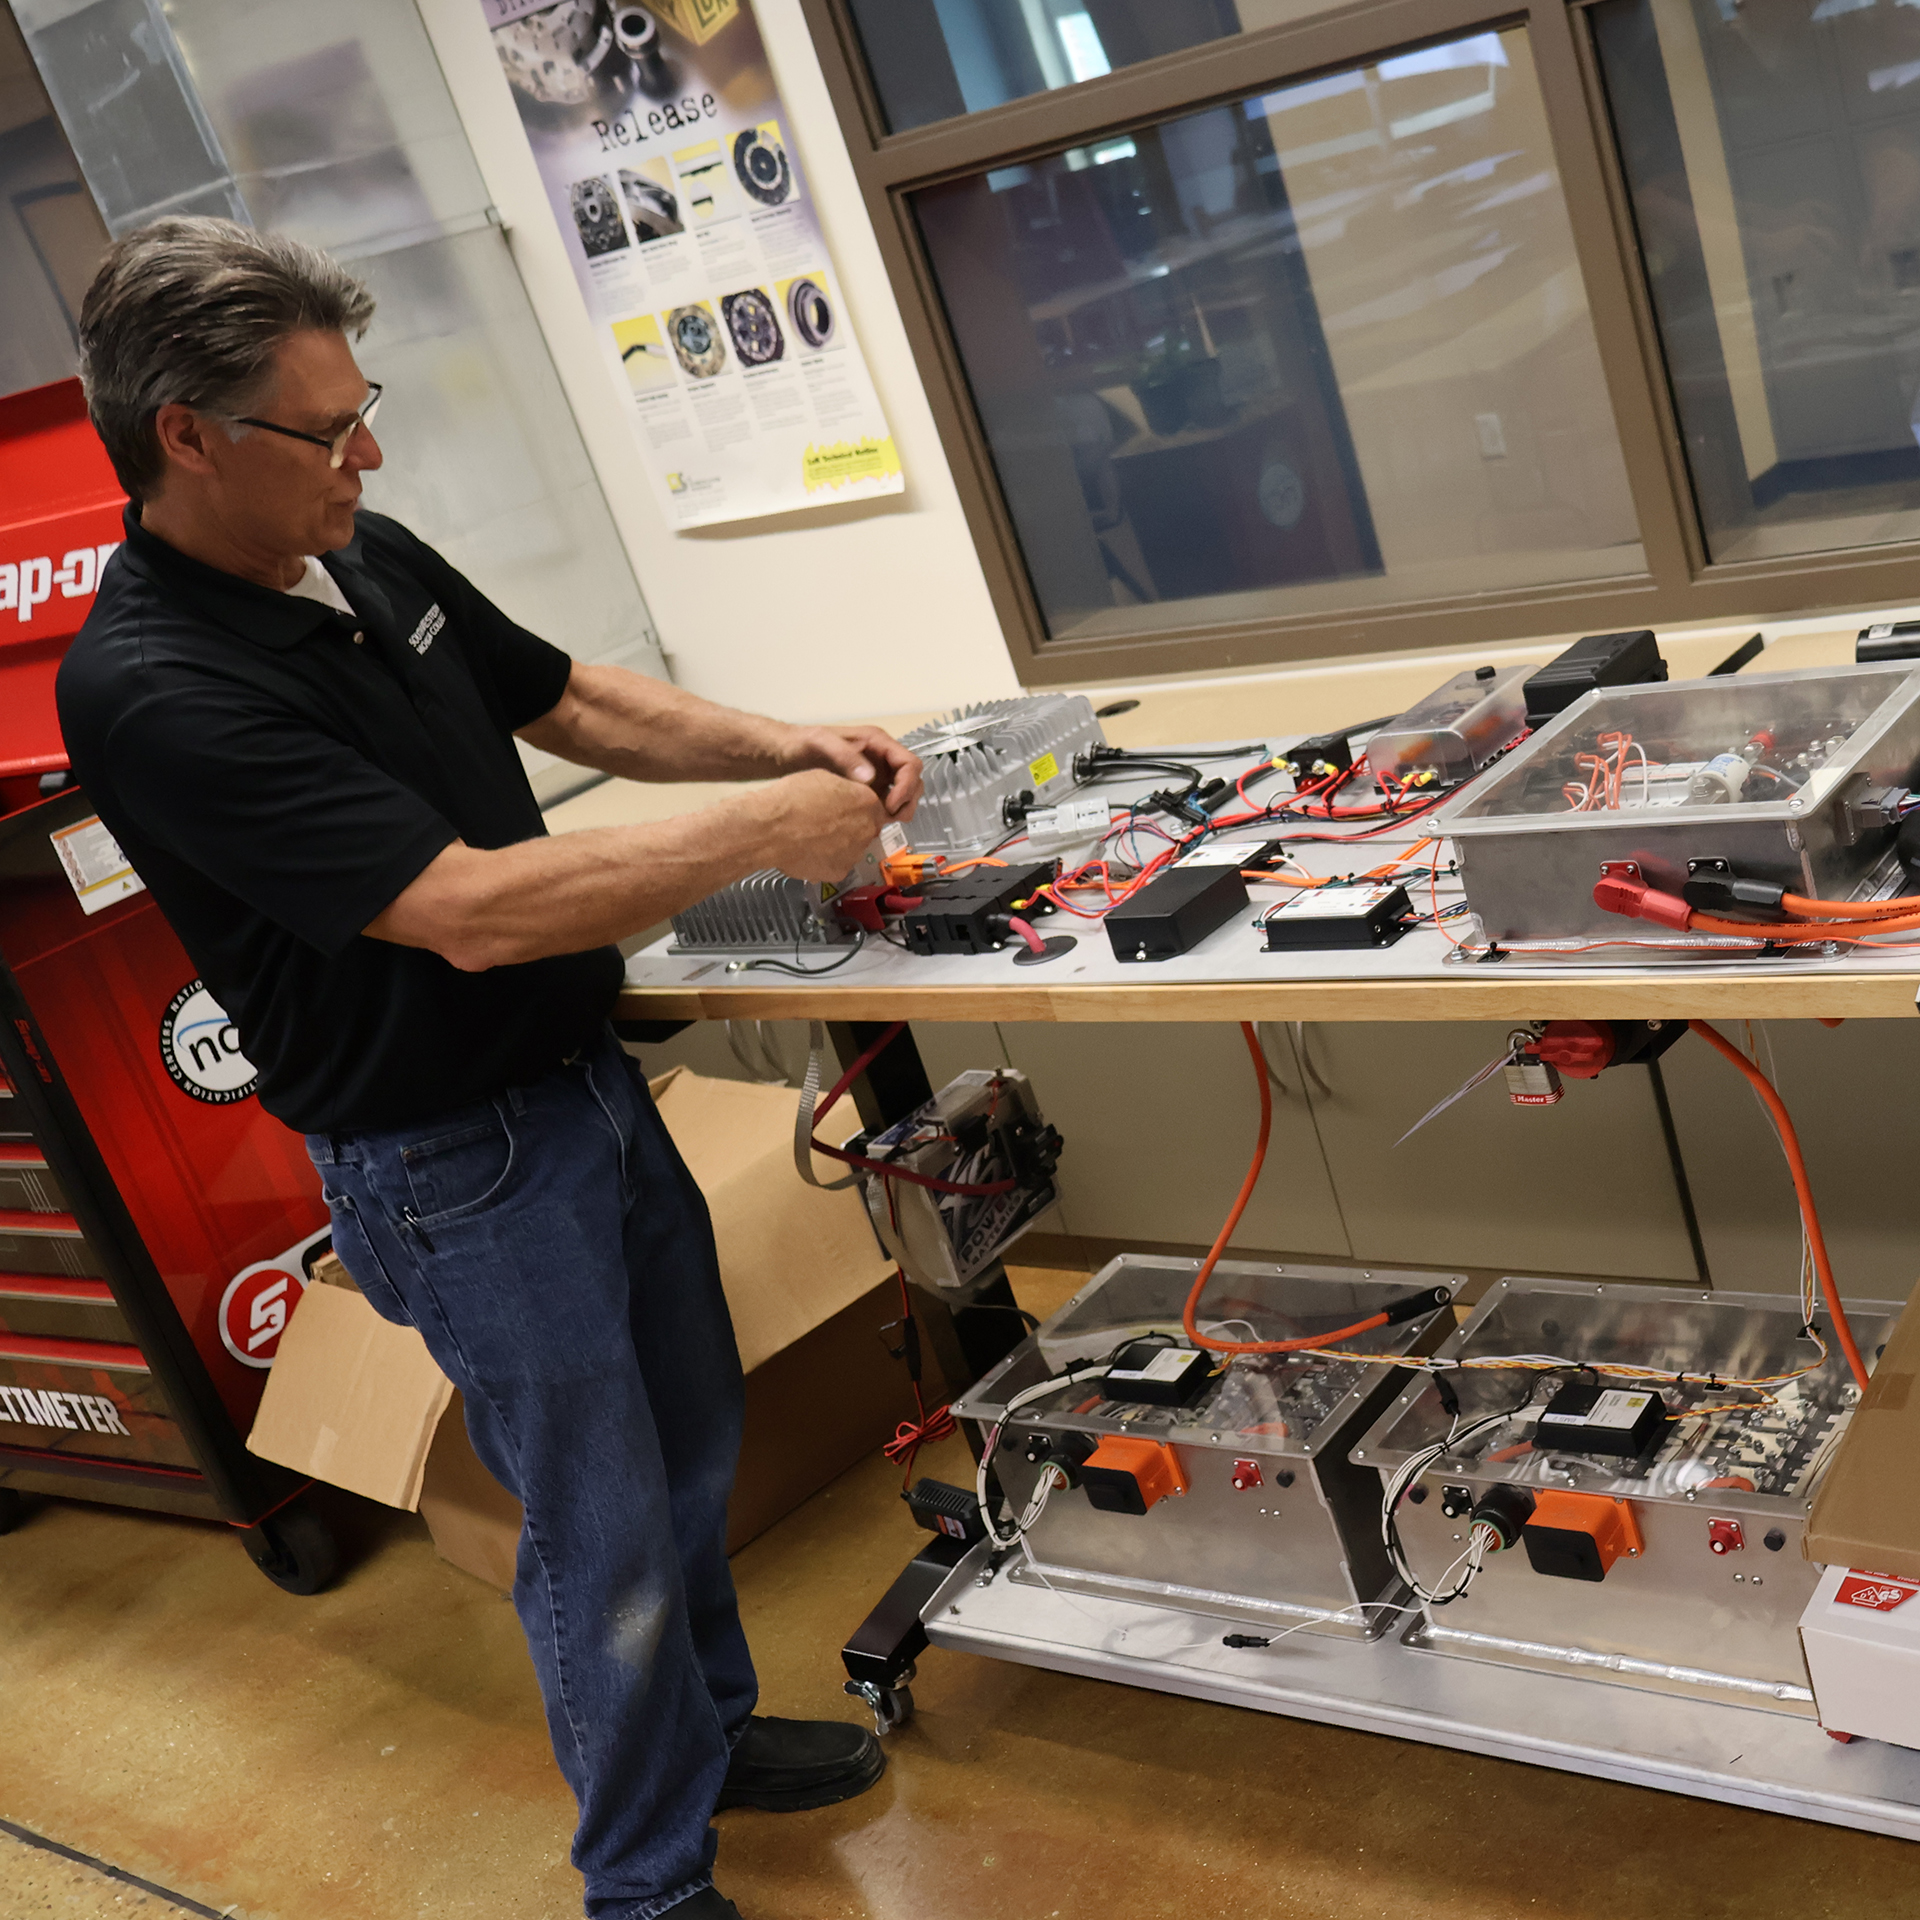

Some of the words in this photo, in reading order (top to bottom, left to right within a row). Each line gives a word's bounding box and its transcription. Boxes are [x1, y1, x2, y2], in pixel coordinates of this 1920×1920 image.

[591, 93, 718, 153] Release
[161, 1019, 183, 1080] CENTERS
[183, 1078, 259, 1103] TIFICATION
[1516, 1095, 1545, 1103] Master
[1879, 1589, 1901, 1601] GS
